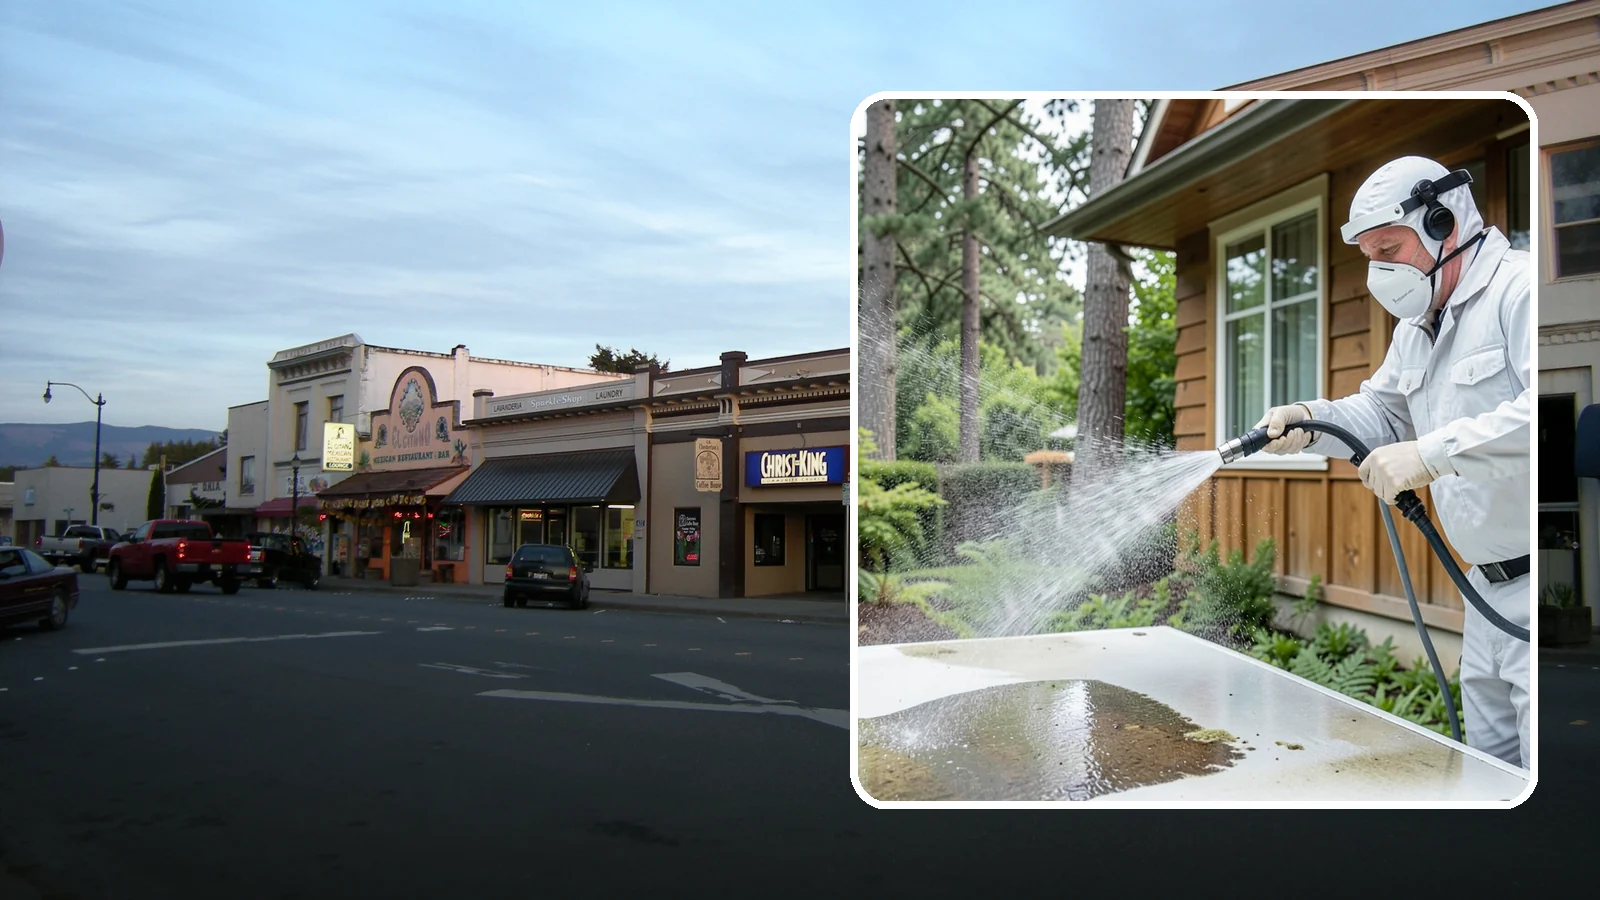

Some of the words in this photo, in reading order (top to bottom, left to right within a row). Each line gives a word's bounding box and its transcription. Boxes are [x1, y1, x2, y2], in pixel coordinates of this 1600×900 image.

[595, 388, 624, 400] LAUNDRY
[493, 402, 522, 413] LAVANDERIA
[373, 454, 396, 464] MEXICAN
[397, 451, 433, 462] RESTAURANT
[437, 450, 450, 459] BAR
[761, 452, 797, 478] CHRIST
[799, 450, 827, 476] KING
[696, 481, 709, 489] Coffee
